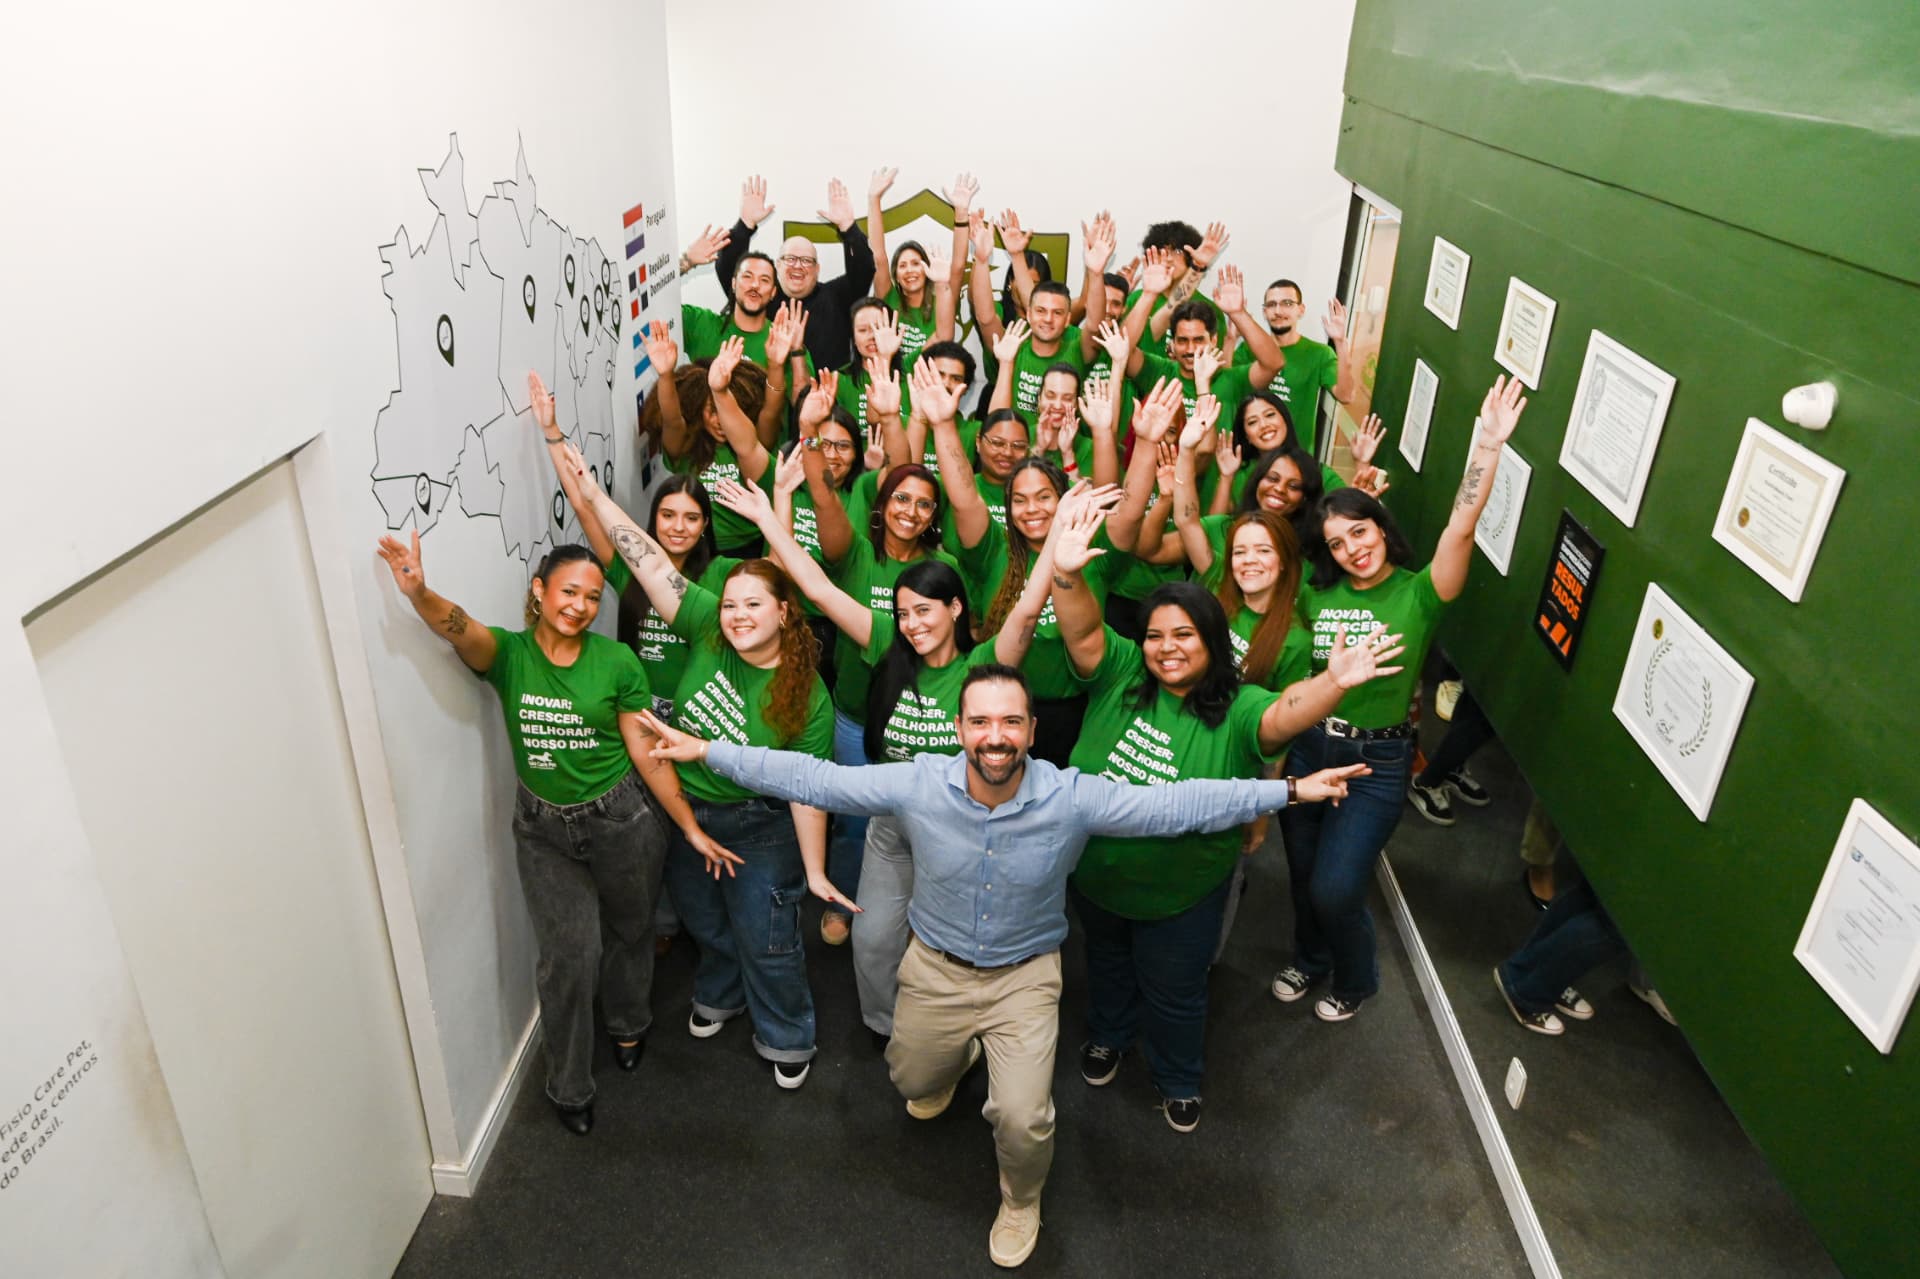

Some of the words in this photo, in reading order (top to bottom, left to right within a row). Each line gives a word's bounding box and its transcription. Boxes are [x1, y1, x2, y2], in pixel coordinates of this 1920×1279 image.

[646, 207, 666, 228] Paraguai
[650, 270, 676, 297] Dominicana
[1552, 577, 1580, 621] TADOS
[1554, 560, 1584, 603] RESUL
[519, 708, 584, 725] CRESCER;
[521, 692, 572, 711] INOVAR;
[684, 699, 720, 736] NOSSO
[693, 690, 750, 745] MELHORAR;
[705, 681, 747, 726] CRESCER;
[520, 722, 597, 737] MELHORAR;
[523, 736, 567, 750] NOSSO
[883, 727, 926, 747] NOSSO
[929, 735, 959, 747] DNA
[1125, 728, 1175, 762] CRESCER;
[1107, 751, 1147, 780] NOSSO
[1115, 739, 1179, 779] MELHORAR;
[0, 1103, 32, 1141] Fisio
[34, 1066, 65, 1102] Care
[66, 1040, 92, 1067] Pet,
[31, 1108, 48, 1131] de
[51, 1053, 98, 1108] centros
[0, 1166, 19, 1190] do
[20, 1116, 64, 1165] Brasil.
